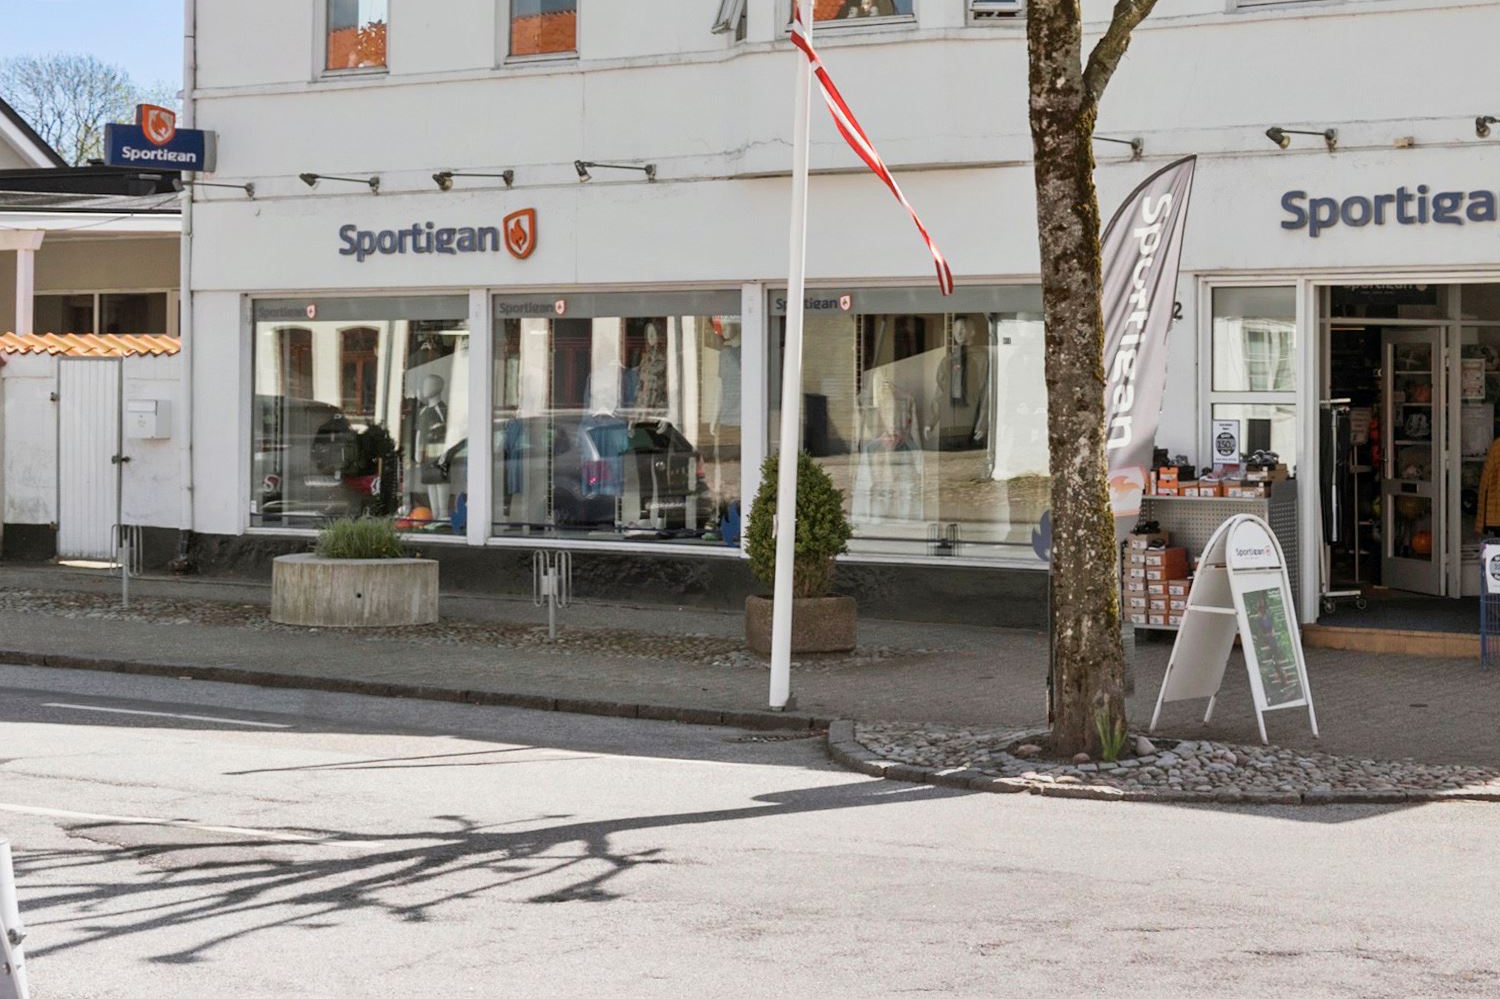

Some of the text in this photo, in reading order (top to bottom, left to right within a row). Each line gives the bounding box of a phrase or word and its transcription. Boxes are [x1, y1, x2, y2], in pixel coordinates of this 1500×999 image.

[122, 146, 196, 163] Sportigan
[338, 221, 499, 263] Sportigan
[775, 297, 838, 312] Sptigan
[1107, 192, 1173, 450] Sportigan
